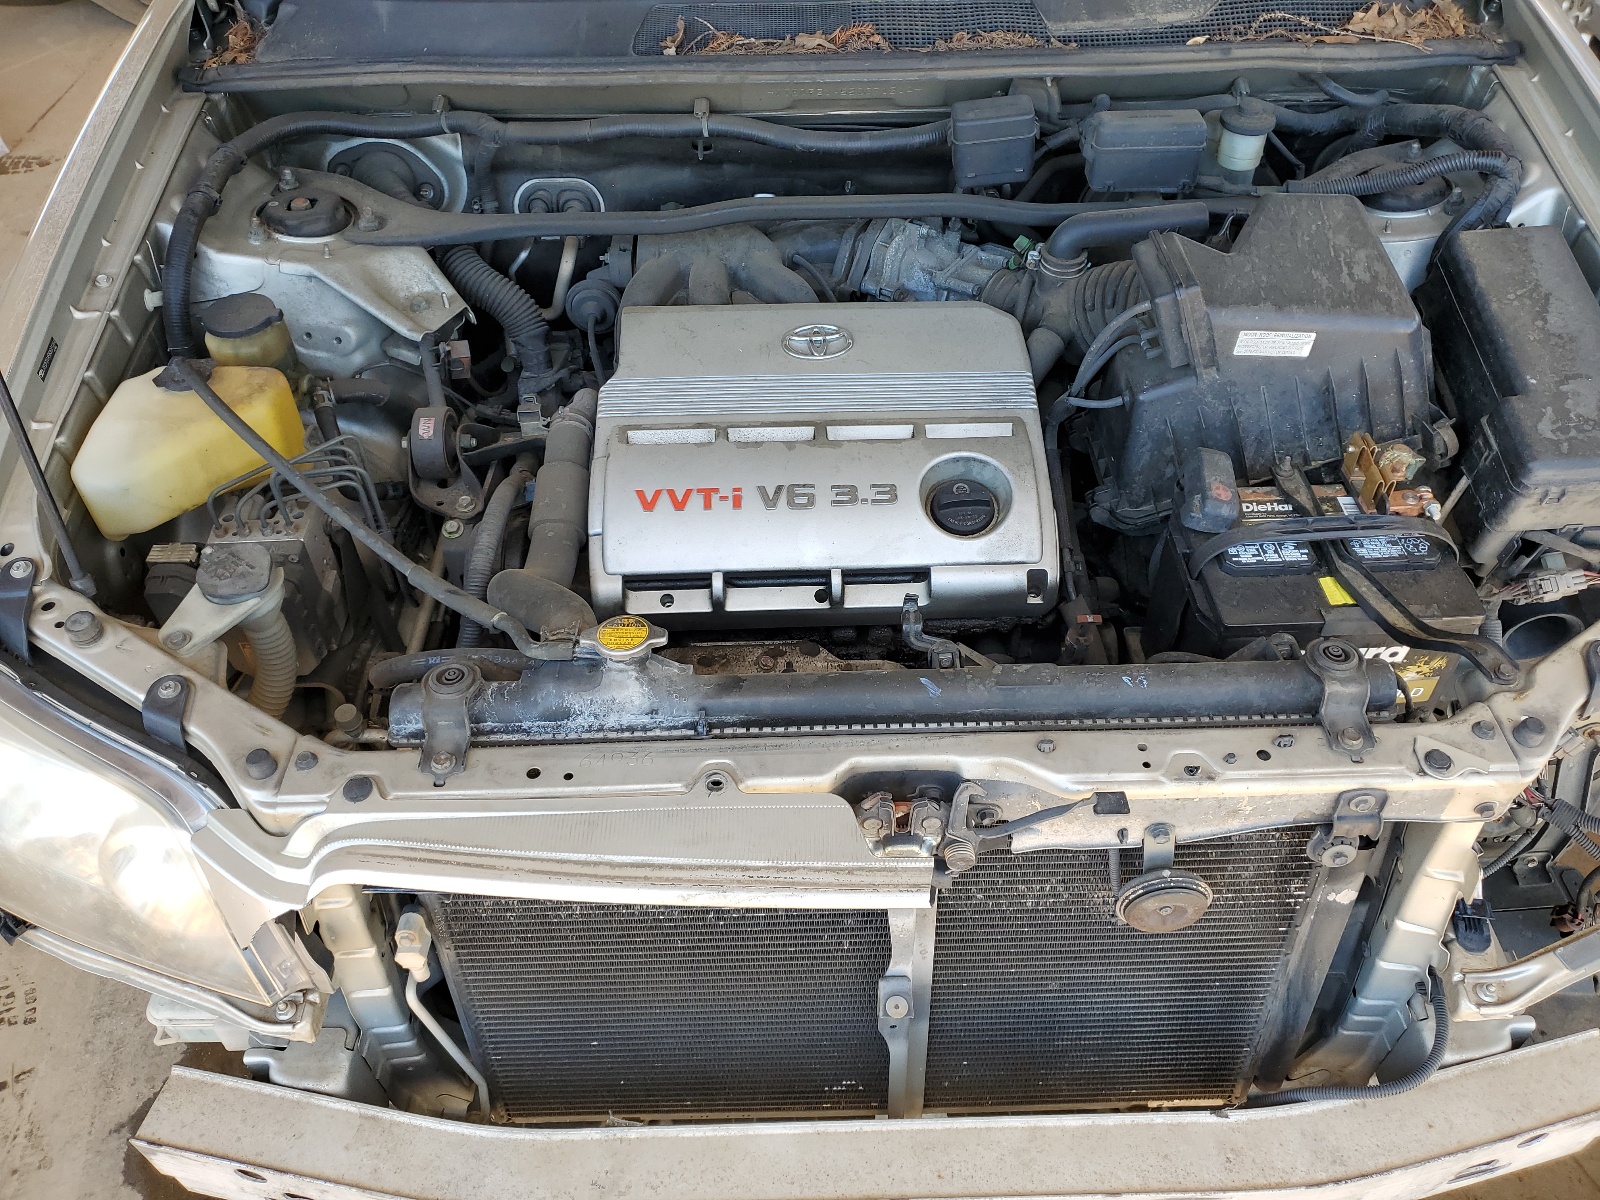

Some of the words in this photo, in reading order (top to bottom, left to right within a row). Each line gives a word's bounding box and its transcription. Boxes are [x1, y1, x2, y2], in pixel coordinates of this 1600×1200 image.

[634, 487, 743, 512] VVT-i
[756, 483, 816, 511] V6
[830, 483, 899, 507] 3.3
